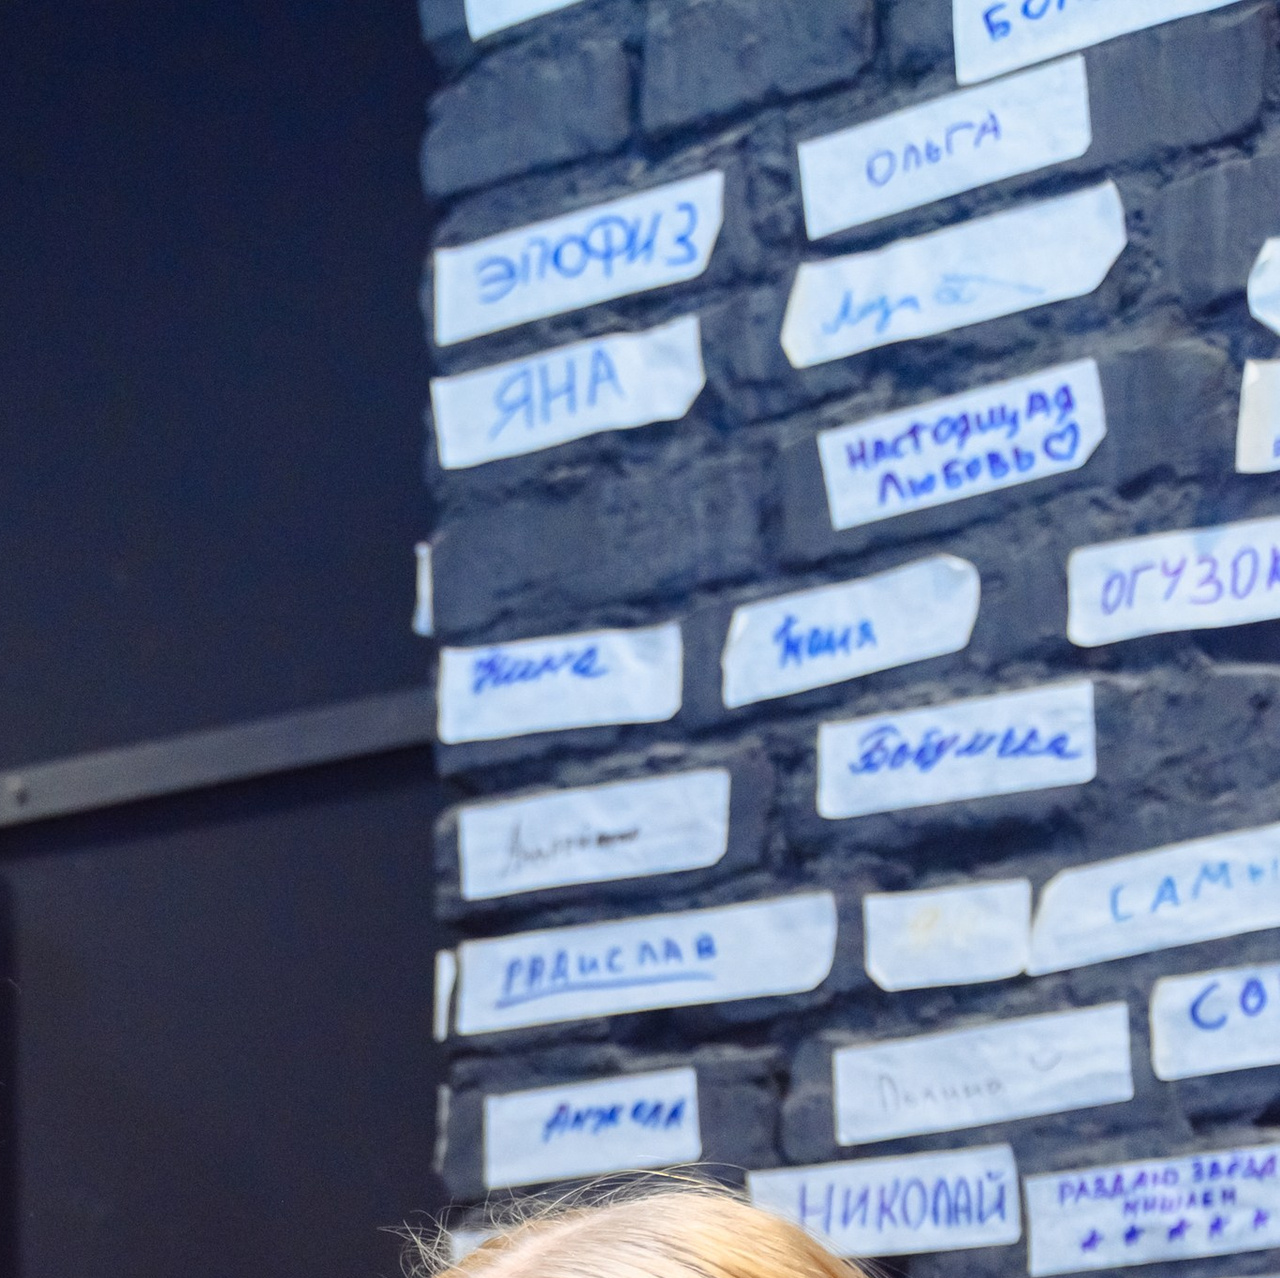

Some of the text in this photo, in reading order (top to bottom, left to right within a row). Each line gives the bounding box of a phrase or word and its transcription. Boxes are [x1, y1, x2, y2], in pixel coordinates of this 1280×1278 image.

[866, 111, 1002, 187] ОЛЬГА
[475, 201, 699, 305] ЭПОФИЗ
[488, 346, 626, 440] ЯНА
[878, 446, 1036, 506] ЛЮБОВЬ
[798, 1169, 1006, 1236] НИКОЛАЙ
